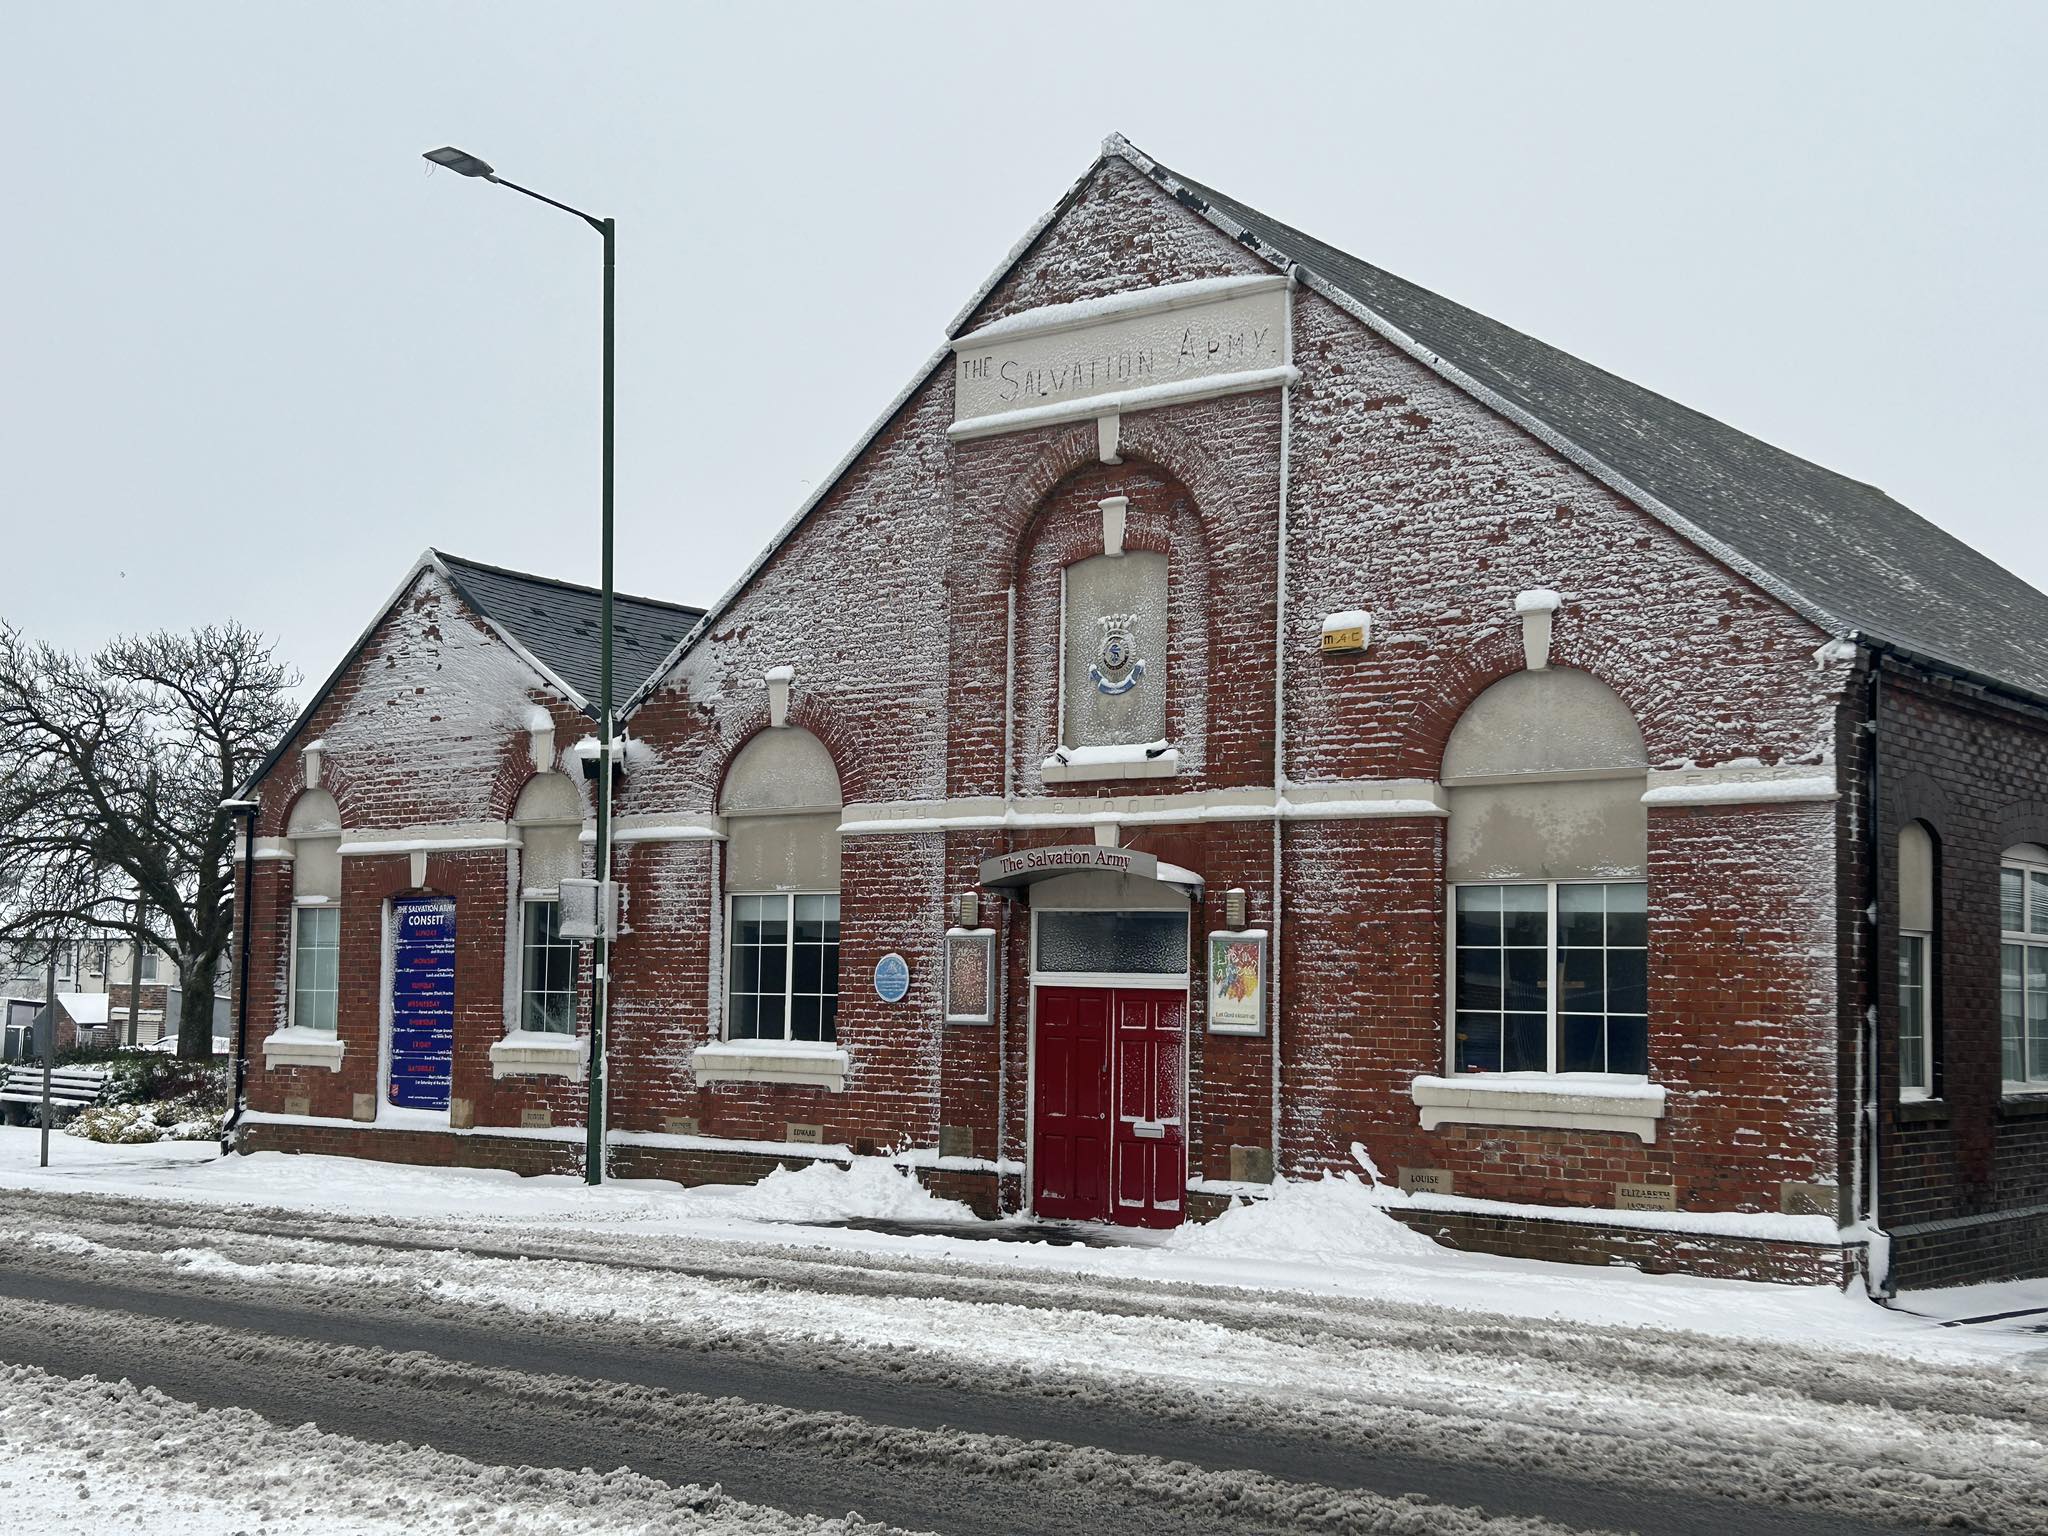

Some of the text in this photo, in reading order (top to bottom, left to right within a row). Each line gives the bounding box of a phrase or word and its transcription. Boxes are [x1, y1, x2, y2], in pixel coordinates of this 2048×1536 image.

[962, 356, 993, 380] THE
[1000, 348, 1153, 402] SALVATION
[1000, 848, 1132, 873] The Salvation Army
[408, 904, 439, 913] SALVATION
[408, 915, 445, 926] CONSETT
[1410, 1173, 1440, 1184] LOUISE
